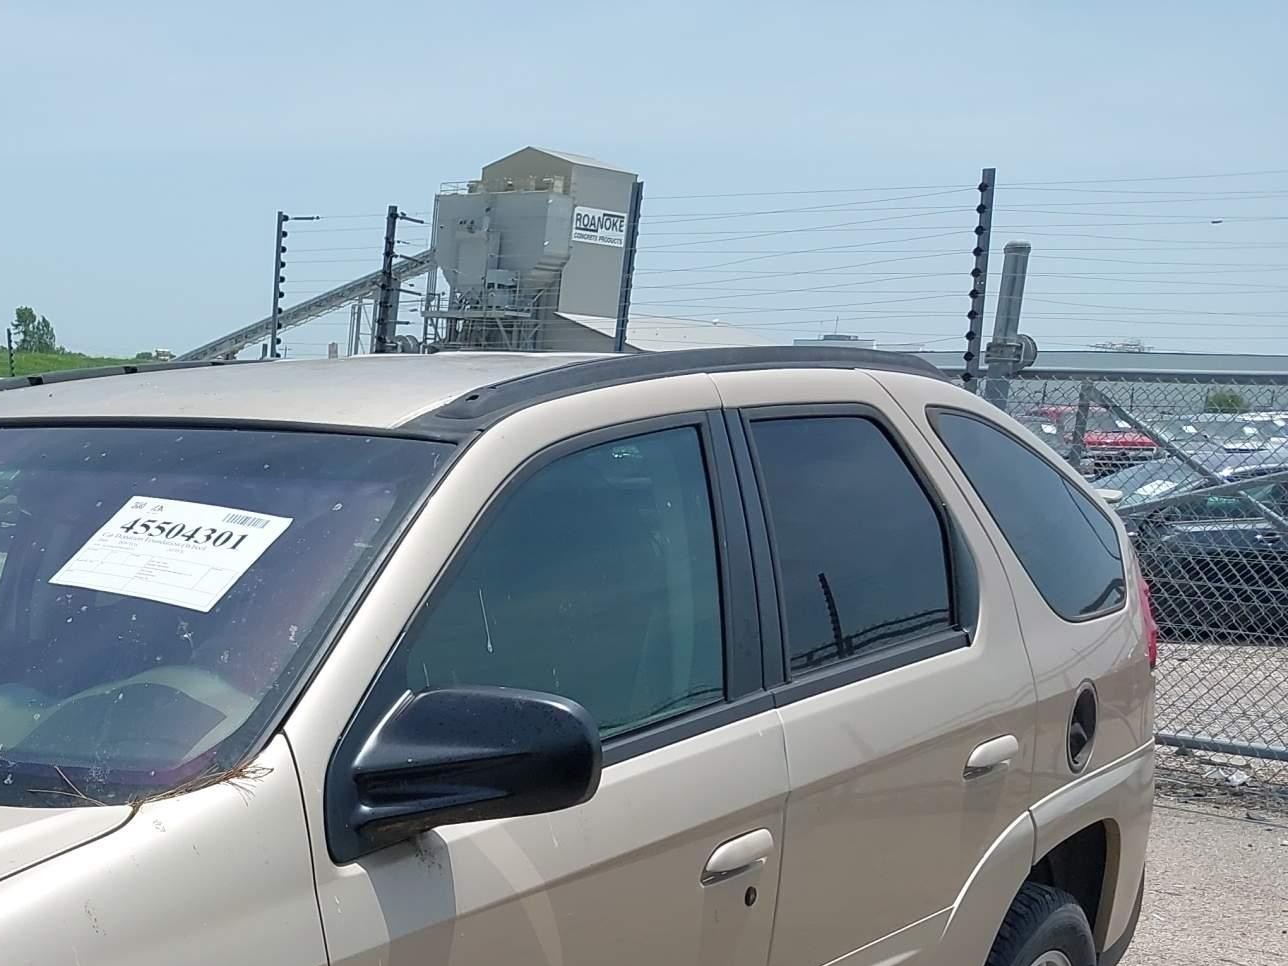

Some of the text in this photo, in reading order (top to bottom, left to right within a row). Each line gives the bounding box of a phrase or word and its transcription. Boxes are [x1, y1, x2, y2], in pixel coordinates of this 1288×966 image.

[575, 213, 624, 232] ROANOKE
[573, 232, 623, 245] CONCRETE PRODUCTS
[120, 517, 249, 550] 45504301
